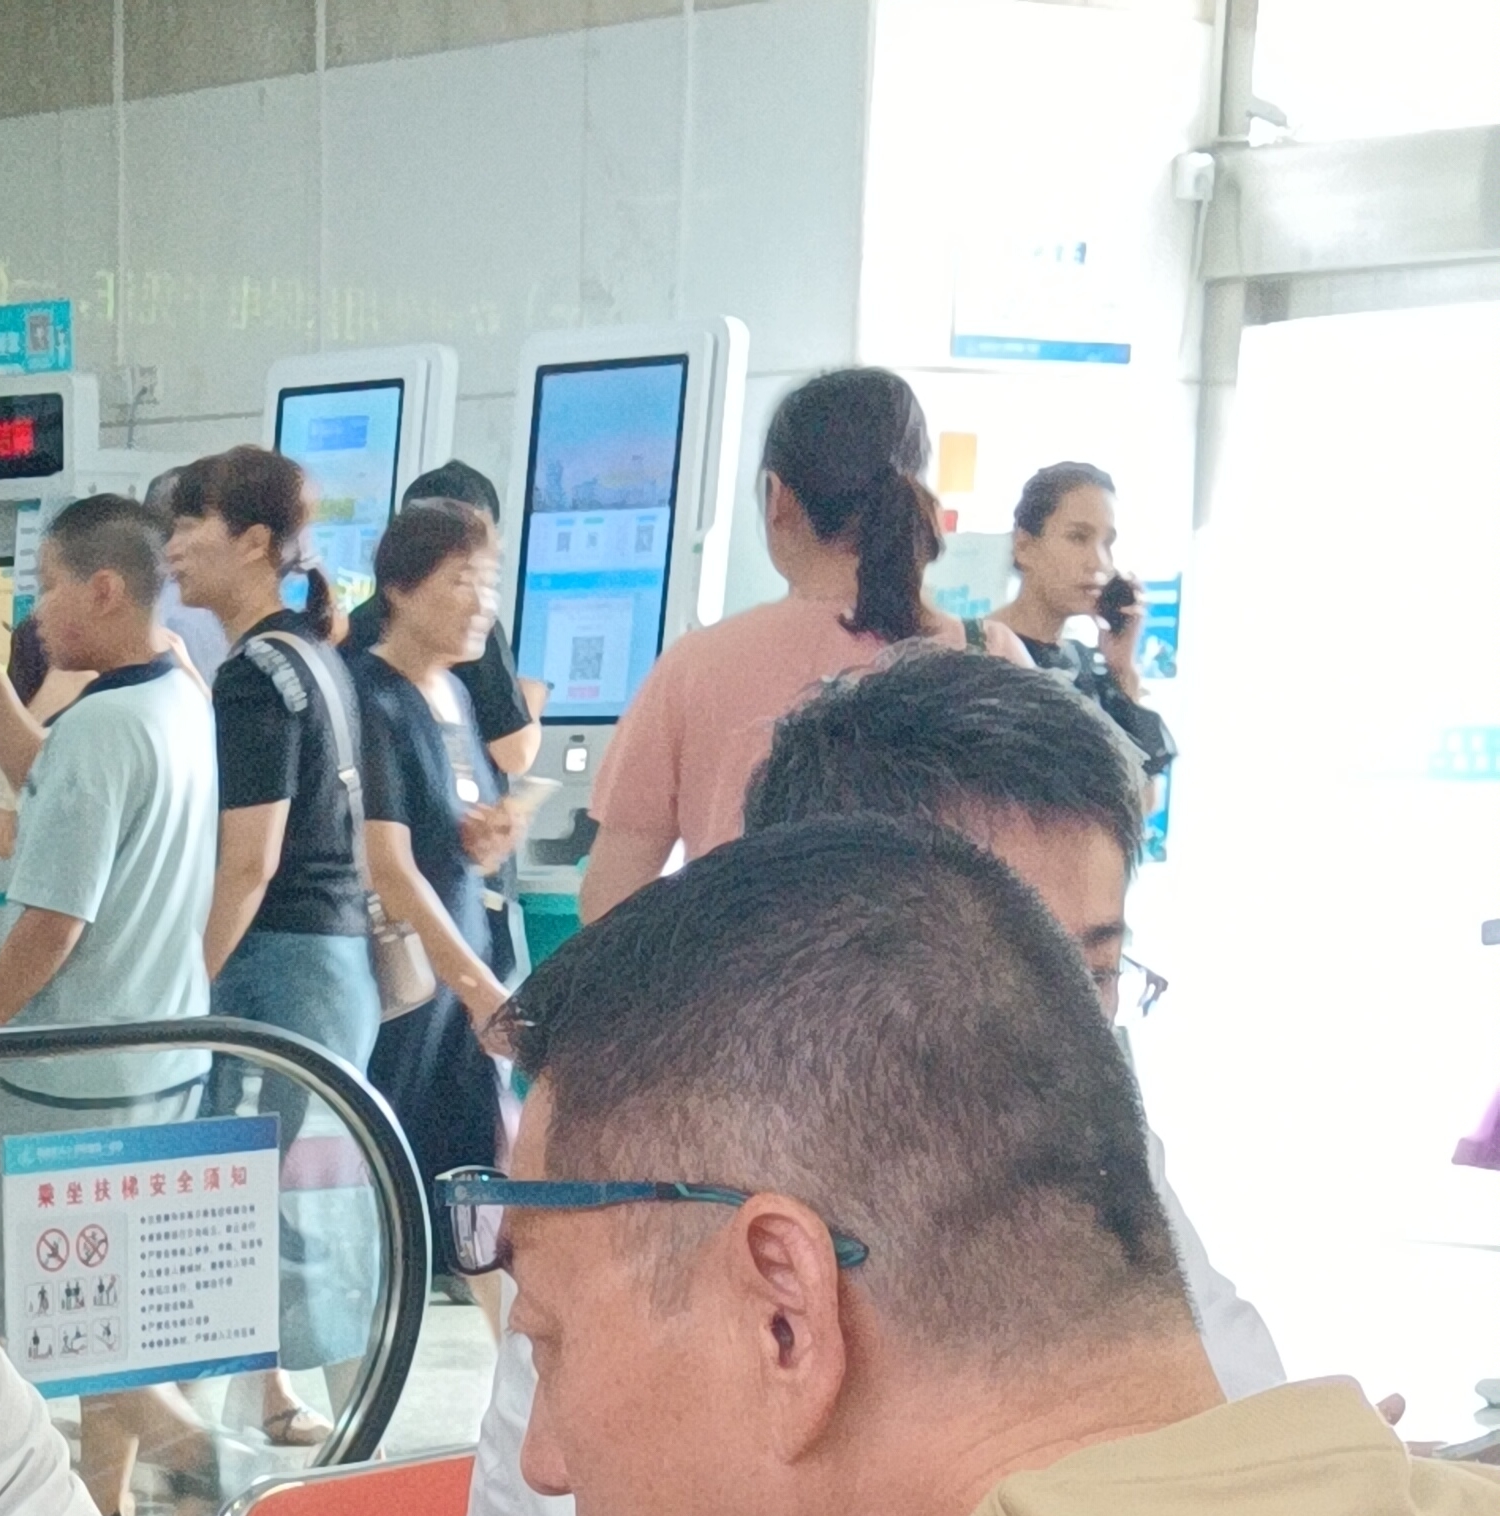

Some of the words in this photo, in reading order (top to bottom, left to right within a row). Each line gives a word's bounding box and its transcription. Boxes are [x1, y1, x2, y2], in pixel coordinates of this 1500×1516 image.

[37, 1164, 248, 1209] 乘坐扶梯安全须知
